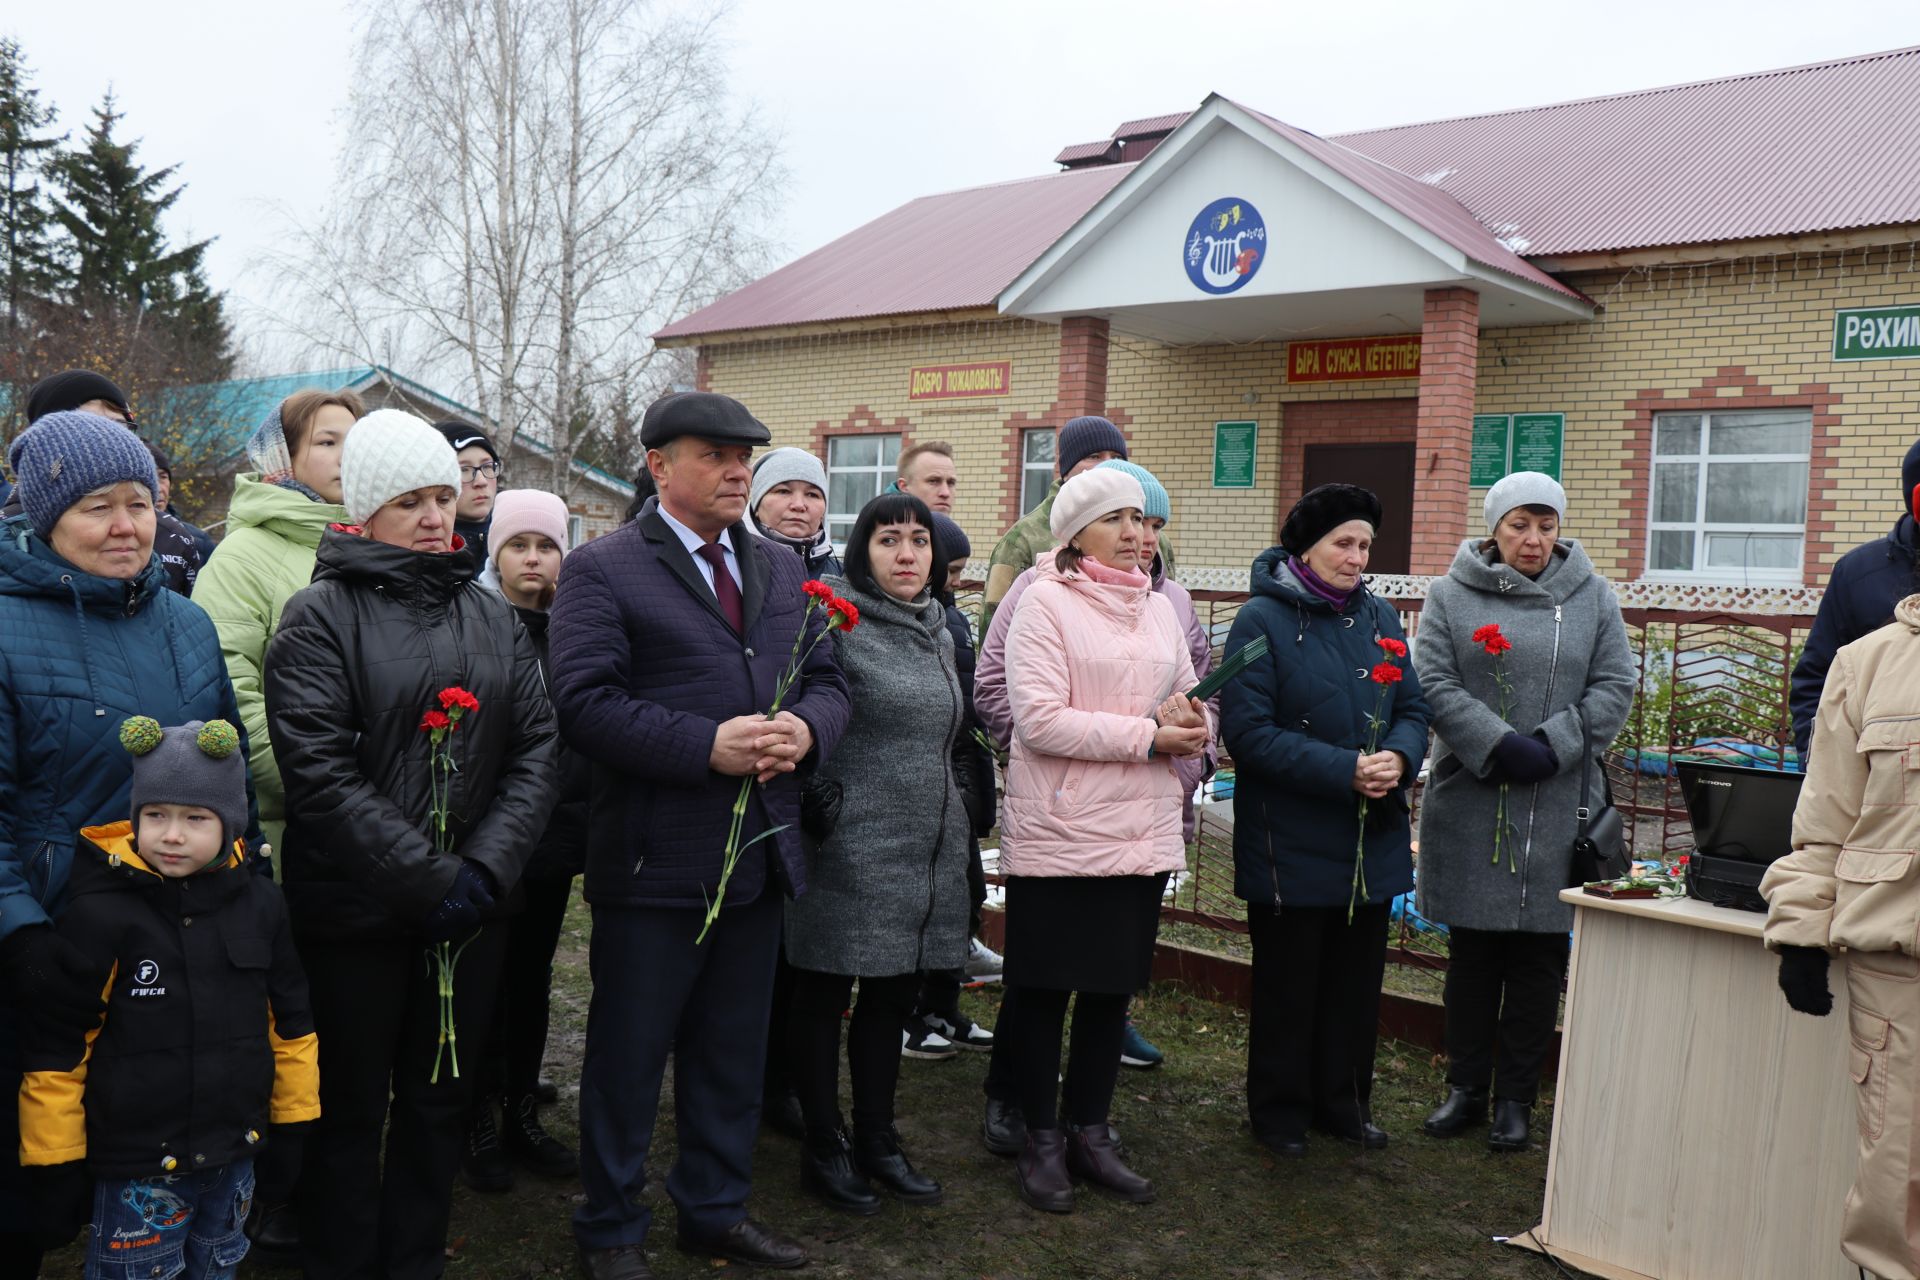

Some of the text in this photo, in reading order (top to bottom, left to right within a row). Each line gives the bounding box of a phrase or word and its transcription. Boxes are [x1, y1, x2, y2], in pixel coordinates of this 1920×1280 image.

[1326, 347, 1361, 374] СУНСА
[946, 368, 1003, 393] ПОЖАЛОВАТЬ!
[1698, 777, 1732, 787] lenovo
[140, 965, 153, 980] F
